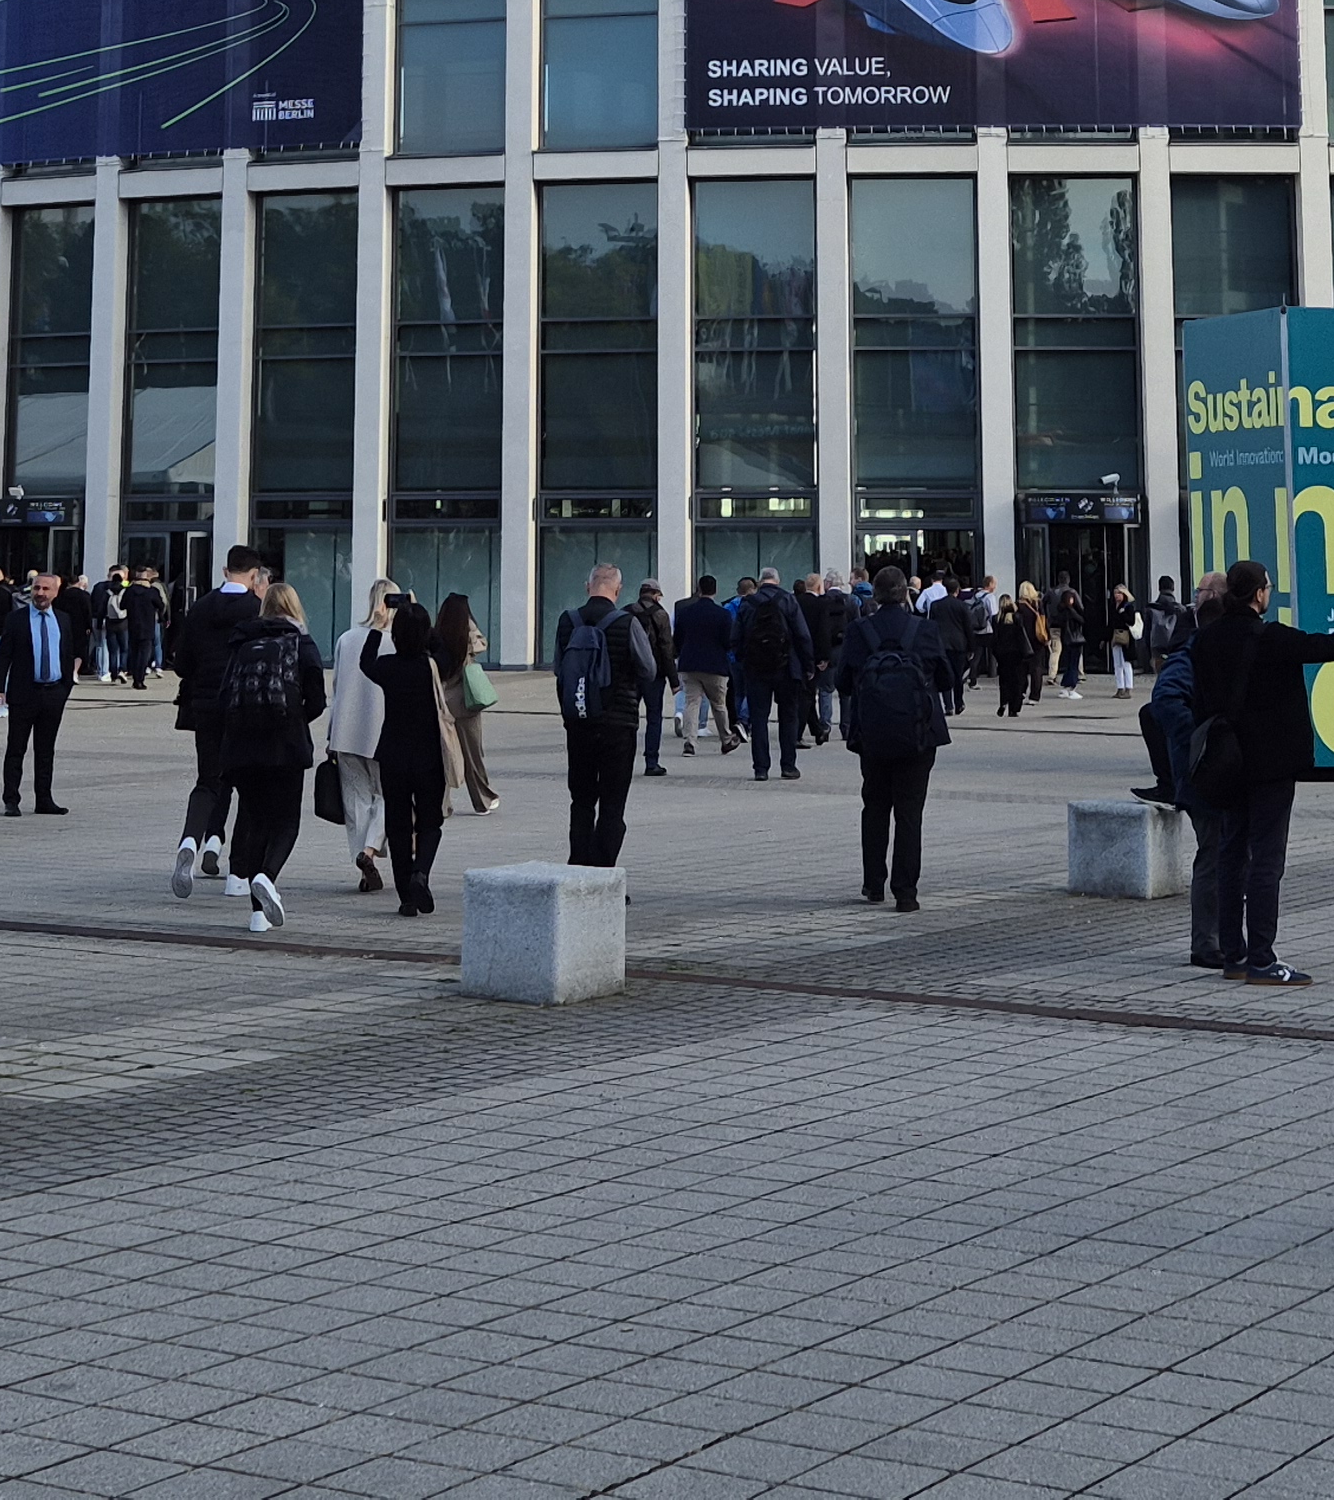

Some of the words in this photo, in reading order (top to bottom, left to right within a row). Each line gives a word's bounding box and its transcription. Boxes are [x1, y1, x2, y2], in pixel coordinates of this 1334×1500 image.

[707, 57, 808, 78] SHARING
[814, 56, 891, 78] VALUE,
[278, 99, 314, 109] MESSE
[708, 87, 808, 107] SHAPING
[814, 85, 951, 105] TOMORROW
[278, 108, 314, 120] BERLIN
[1209, 450, 1234, 467] World
[575, 676, 587, 719] adidas
